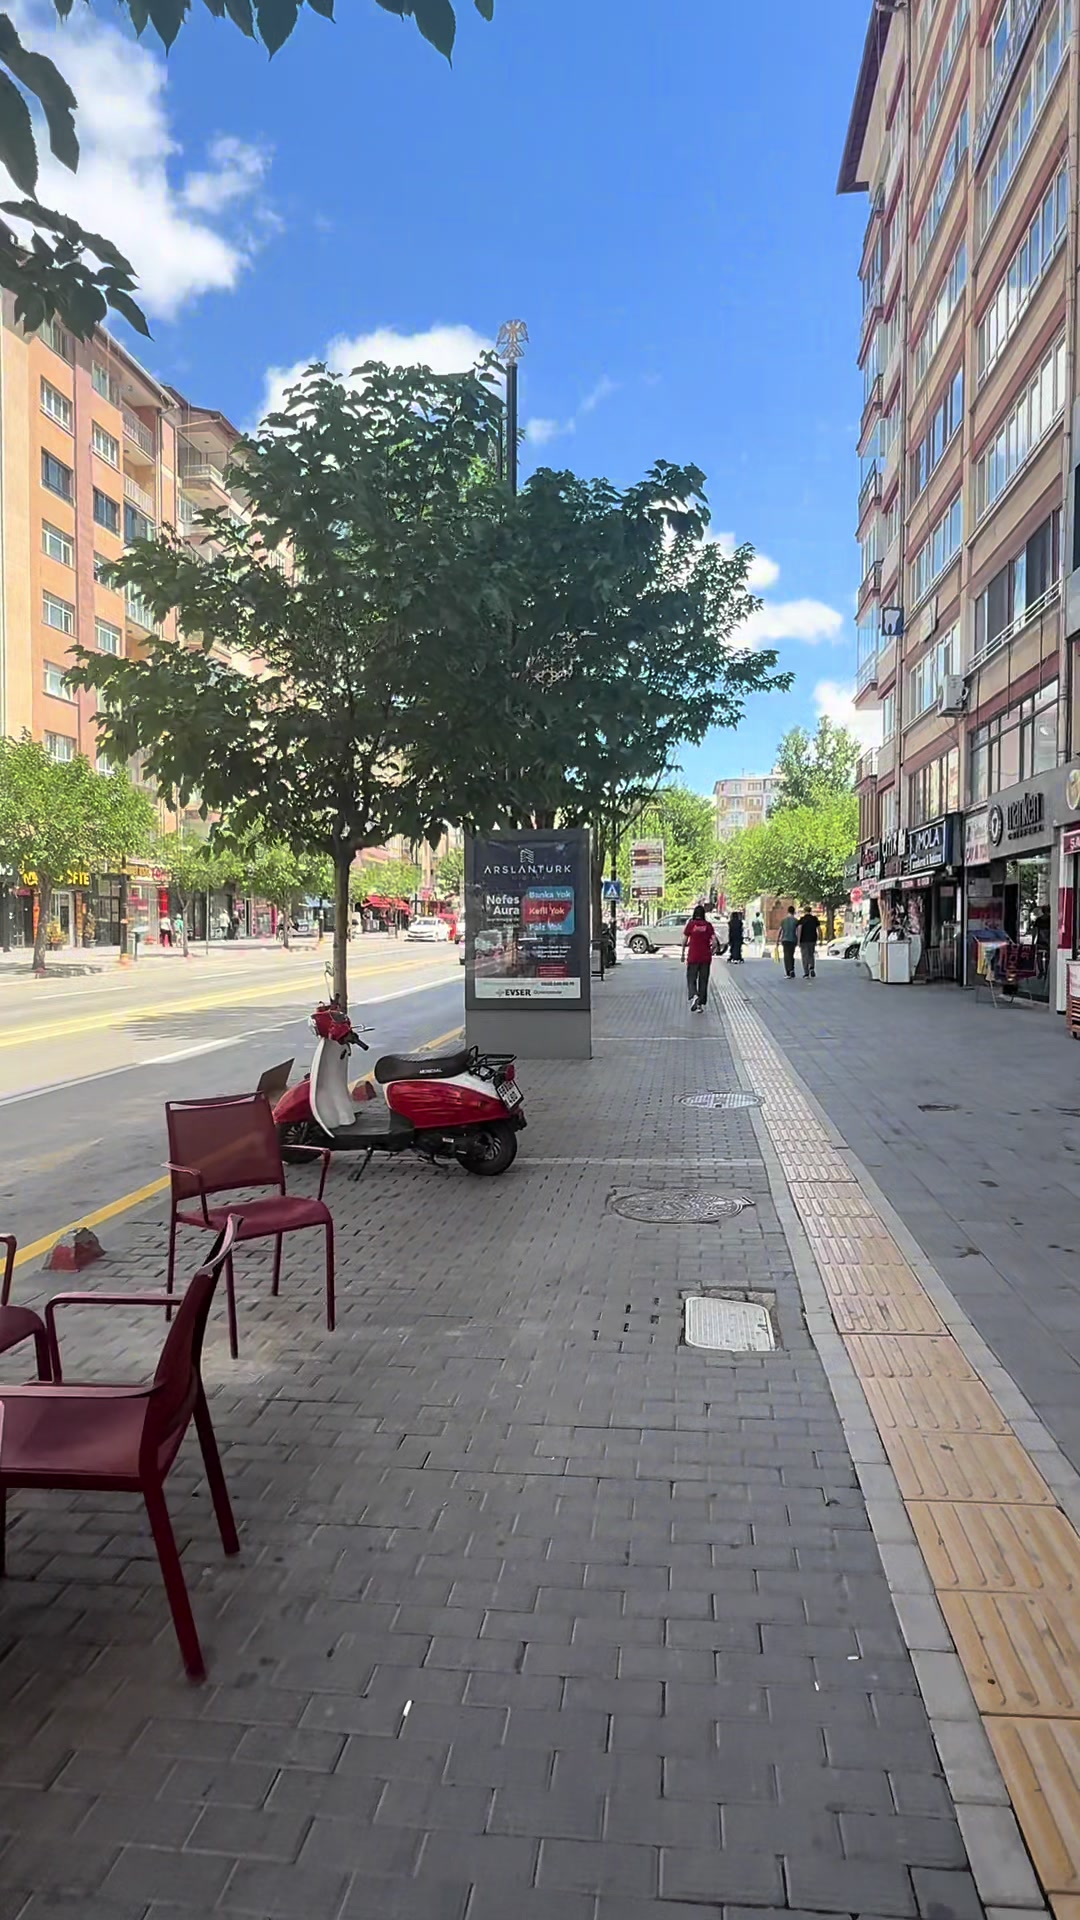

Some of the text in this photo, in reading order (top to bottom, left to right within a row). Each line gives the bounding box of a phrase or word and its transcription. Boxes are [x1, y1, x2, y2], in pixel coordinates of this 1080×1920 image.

[529, 890, 571, 898] Banka Yok
[486, 894, 520, 905] Nefes
[493, 905, 520, 915] Aura
[550, 907, 565, 915] Yok
[548, 923, 562, 931] Yok
[505, 989, 531, 997] EVSER
